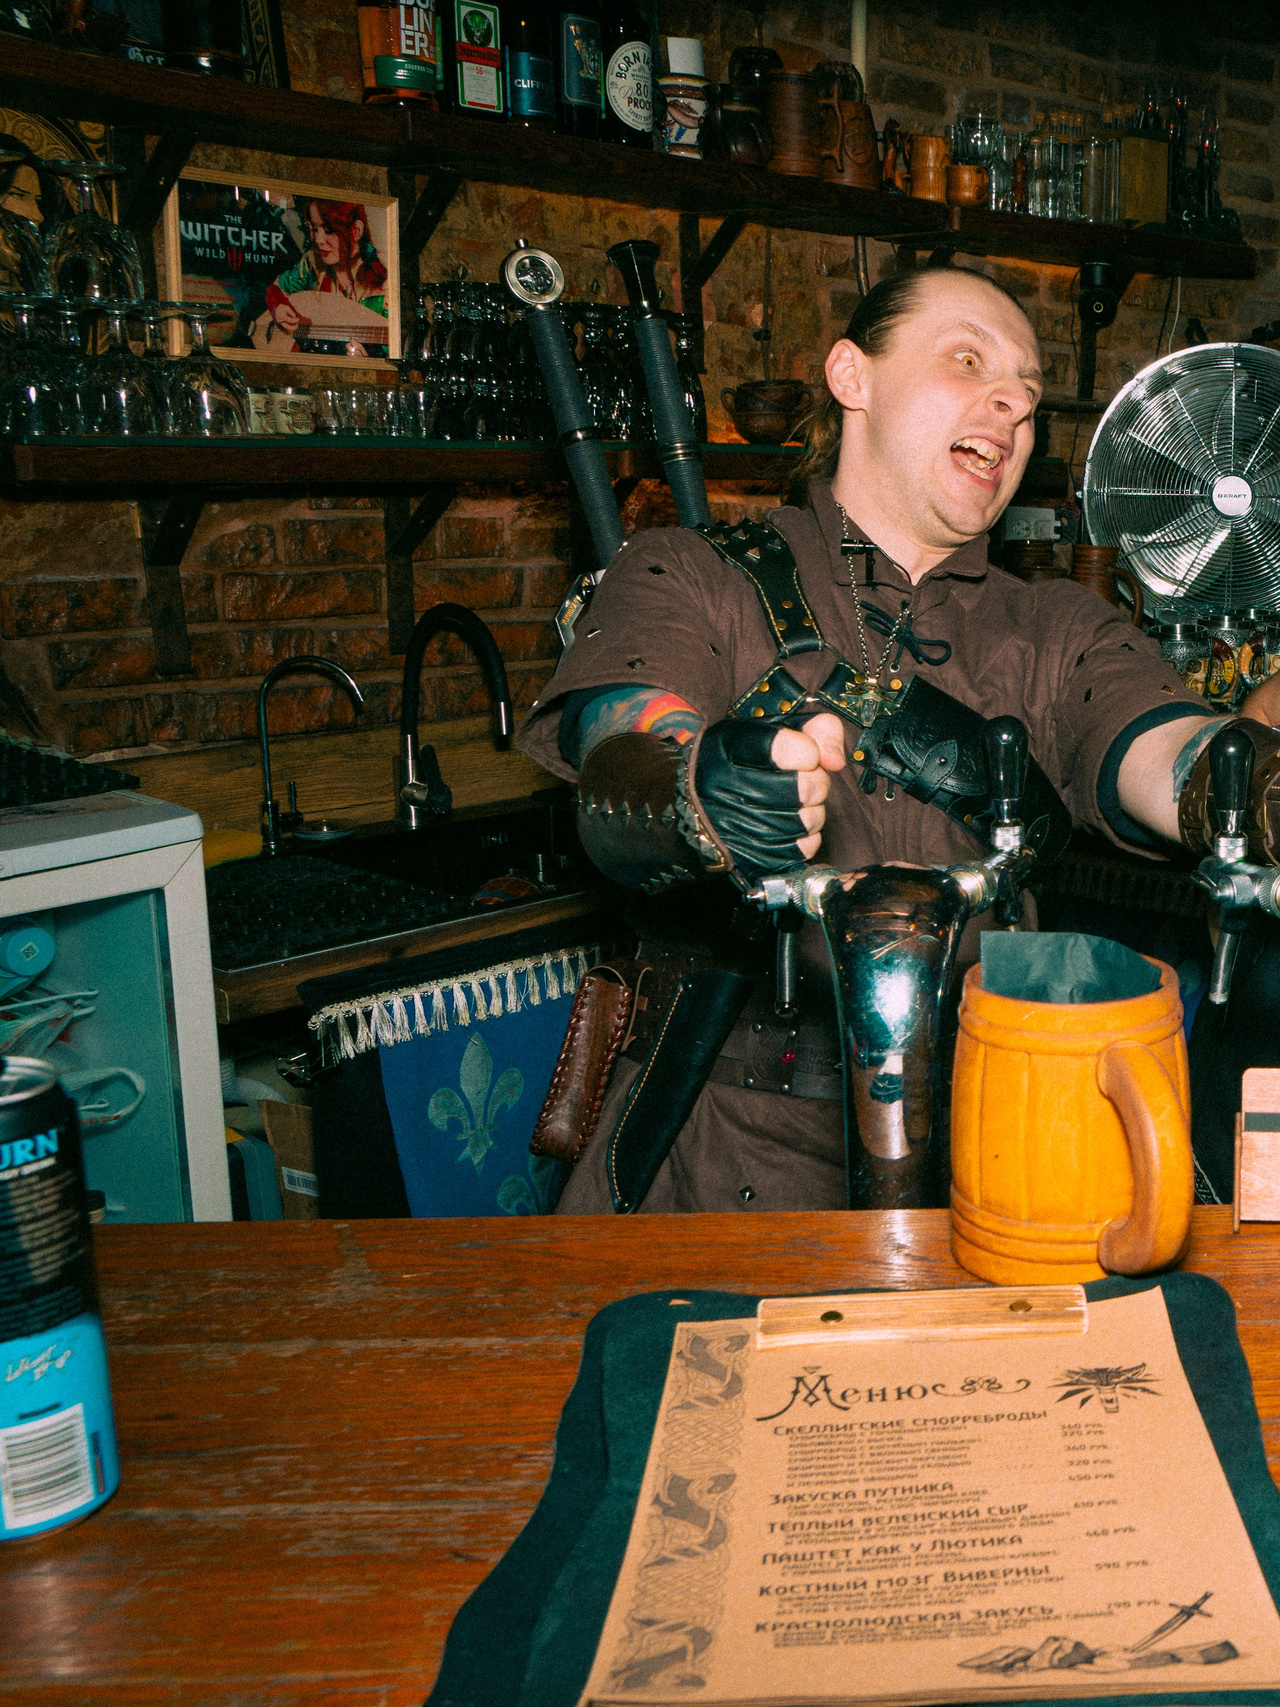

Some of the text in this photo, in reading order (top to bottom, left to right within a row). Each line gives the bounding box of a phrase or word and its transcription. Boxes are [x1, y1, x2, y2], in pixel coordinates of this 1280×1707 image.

[615, 51, 641, 80] BORN
[223, 214, 243, 225] THE
[179, 220, 288, 254] WITCHER
[194, 246, 276, 265] WILD HUNT
[769, 1481, 955, 1506] ЗАКУСКА ПУТНИКА
[986, 1503, 1029, 1517] СЫР
[761, 1547, 852, 1565] ПАШТЕТ
[861, 1543, 901, 1558] КАК
[909, 1541, 922, 1555] У
[758, 1564, 1050, 1597] КОСТНЫЙ МОЗГ ВИВЕРНЫ
[754, 1603, 1054, 1633] КРАСНОЛЮДСКАЯ ЗАКУСЬ
